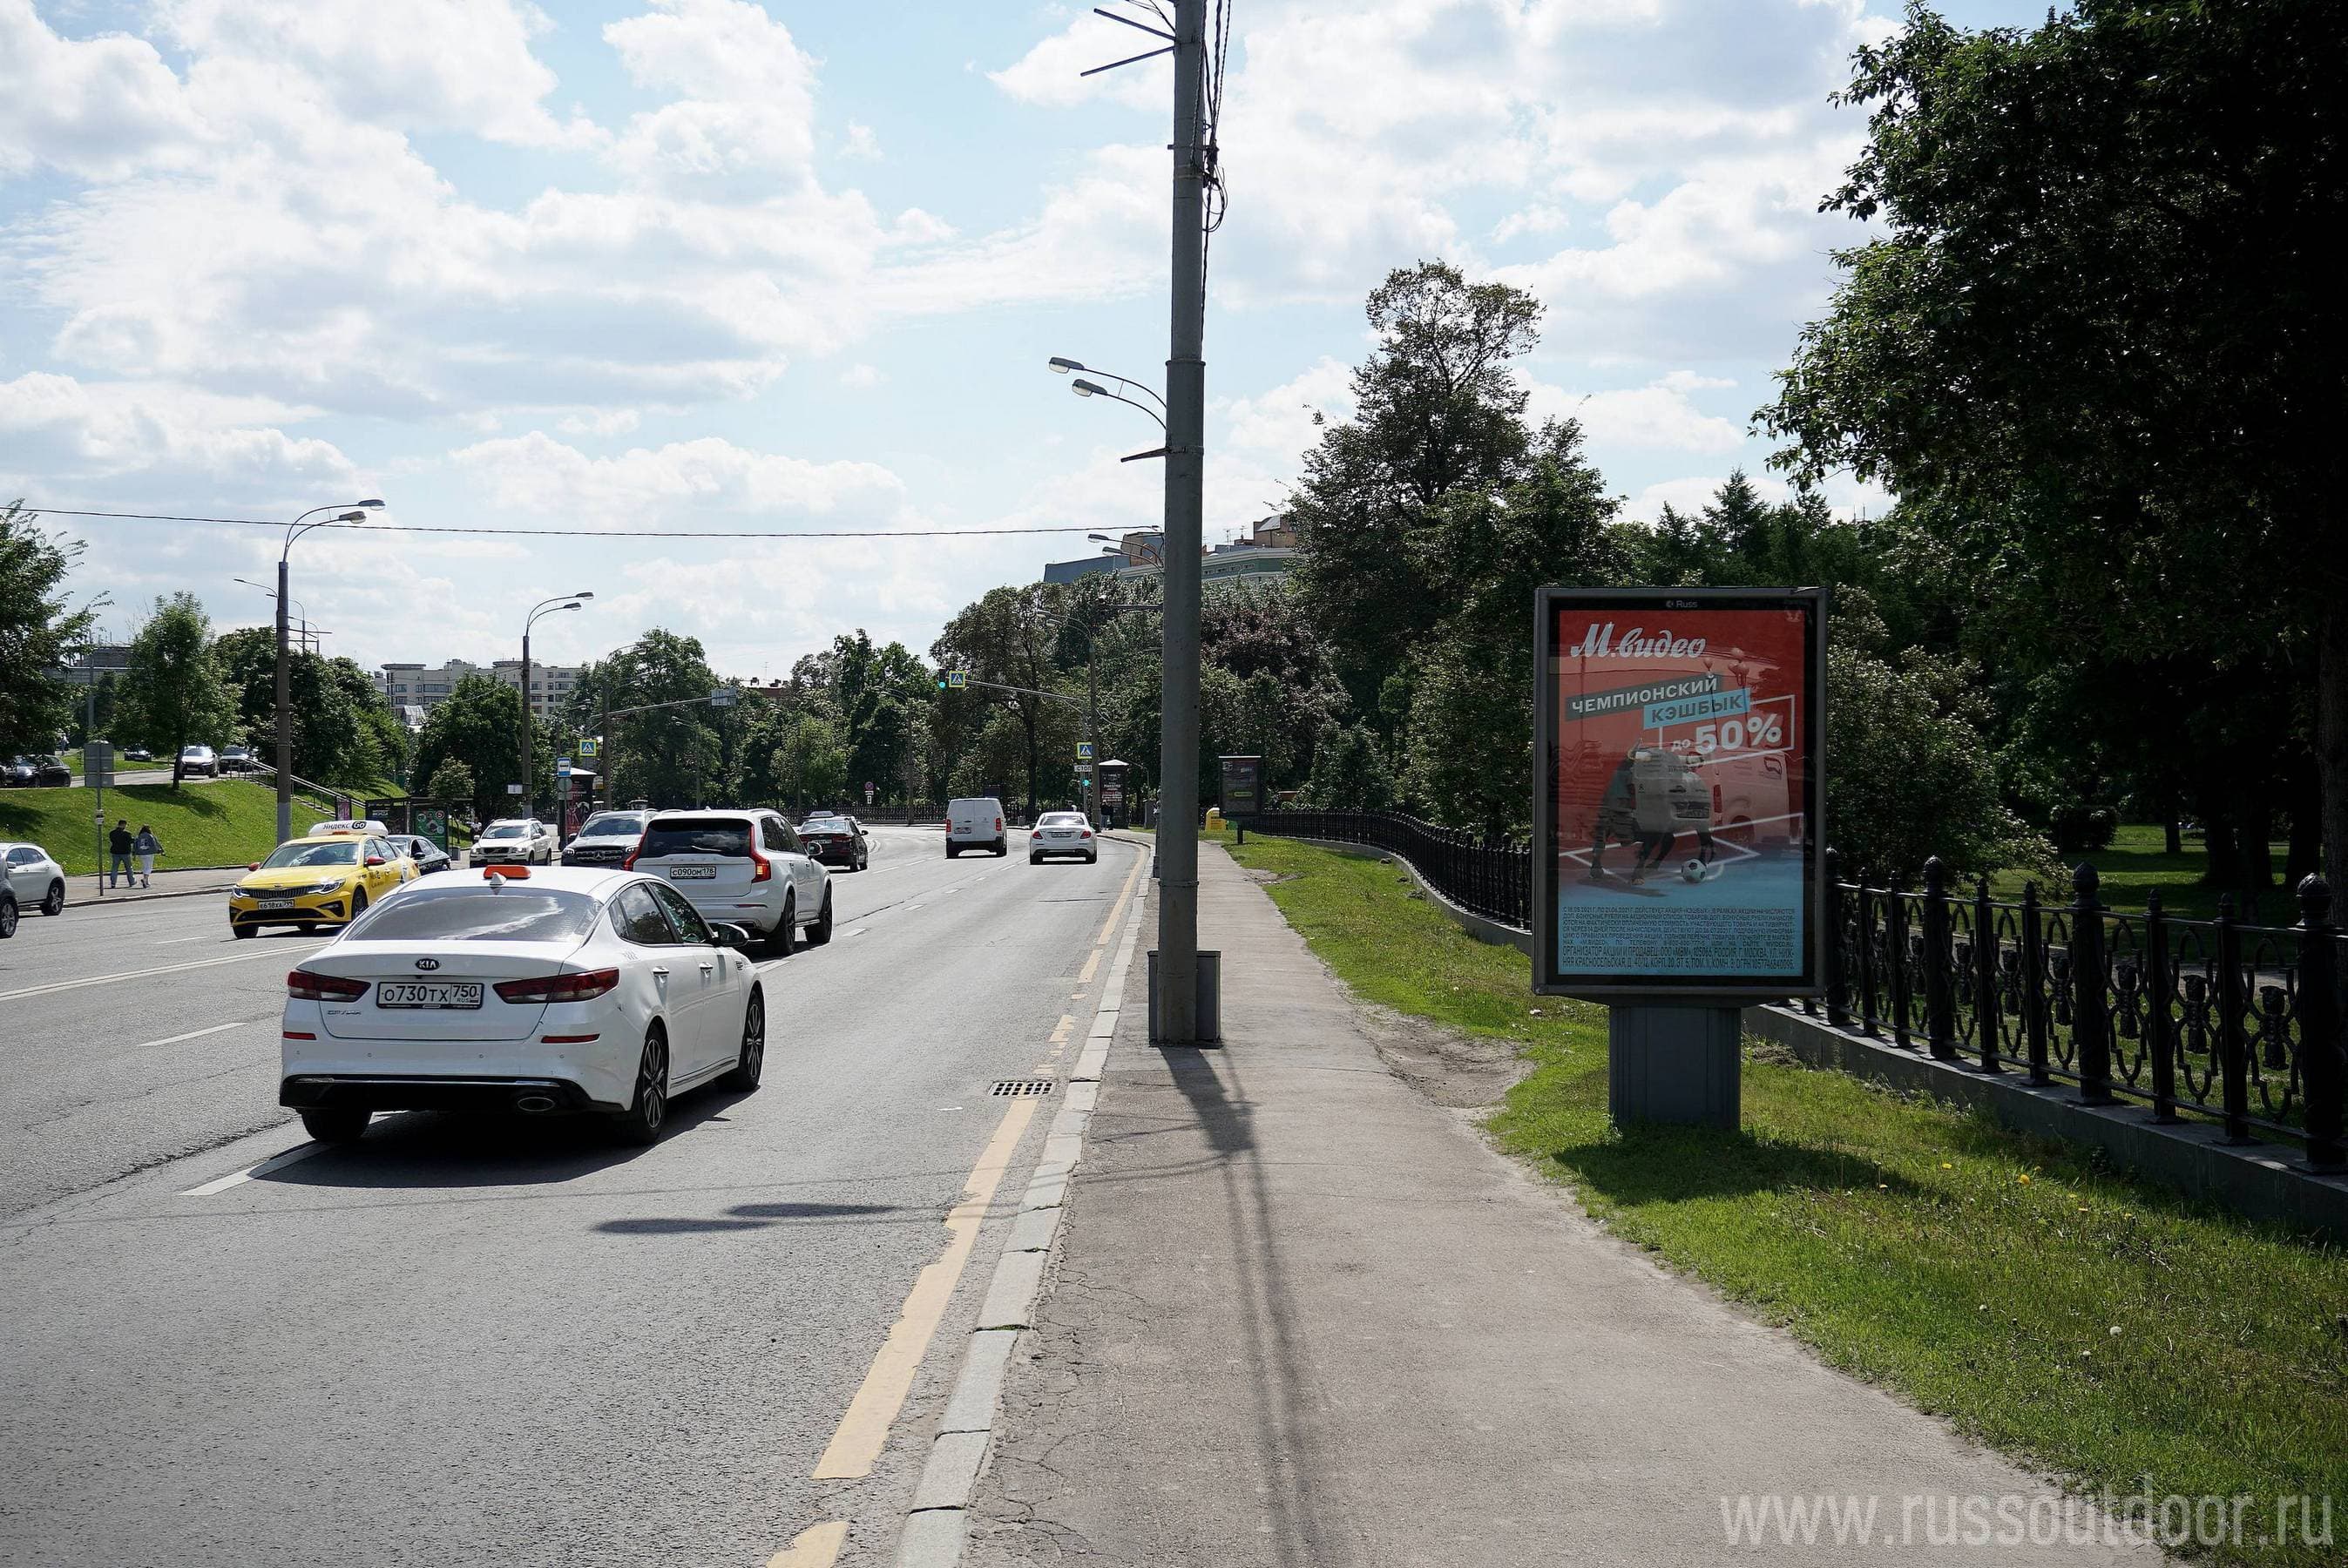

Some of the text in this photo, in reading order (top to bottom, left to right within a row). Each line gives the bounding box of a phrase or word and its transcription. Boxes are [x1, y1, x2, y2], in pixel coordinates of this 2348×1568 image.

[1570, 622, 1708, 659] М.видео
[1572, 673, 1719, 713] ЧЕМПИОНСКИЙ
[1652, 694, 1743, 723] КЭШБЫК
[1671, 713, 1783, 755] до 50%
[418, 960, 437, 969] KIA
[384, 985, 477, 1003] О730ТХ 750
